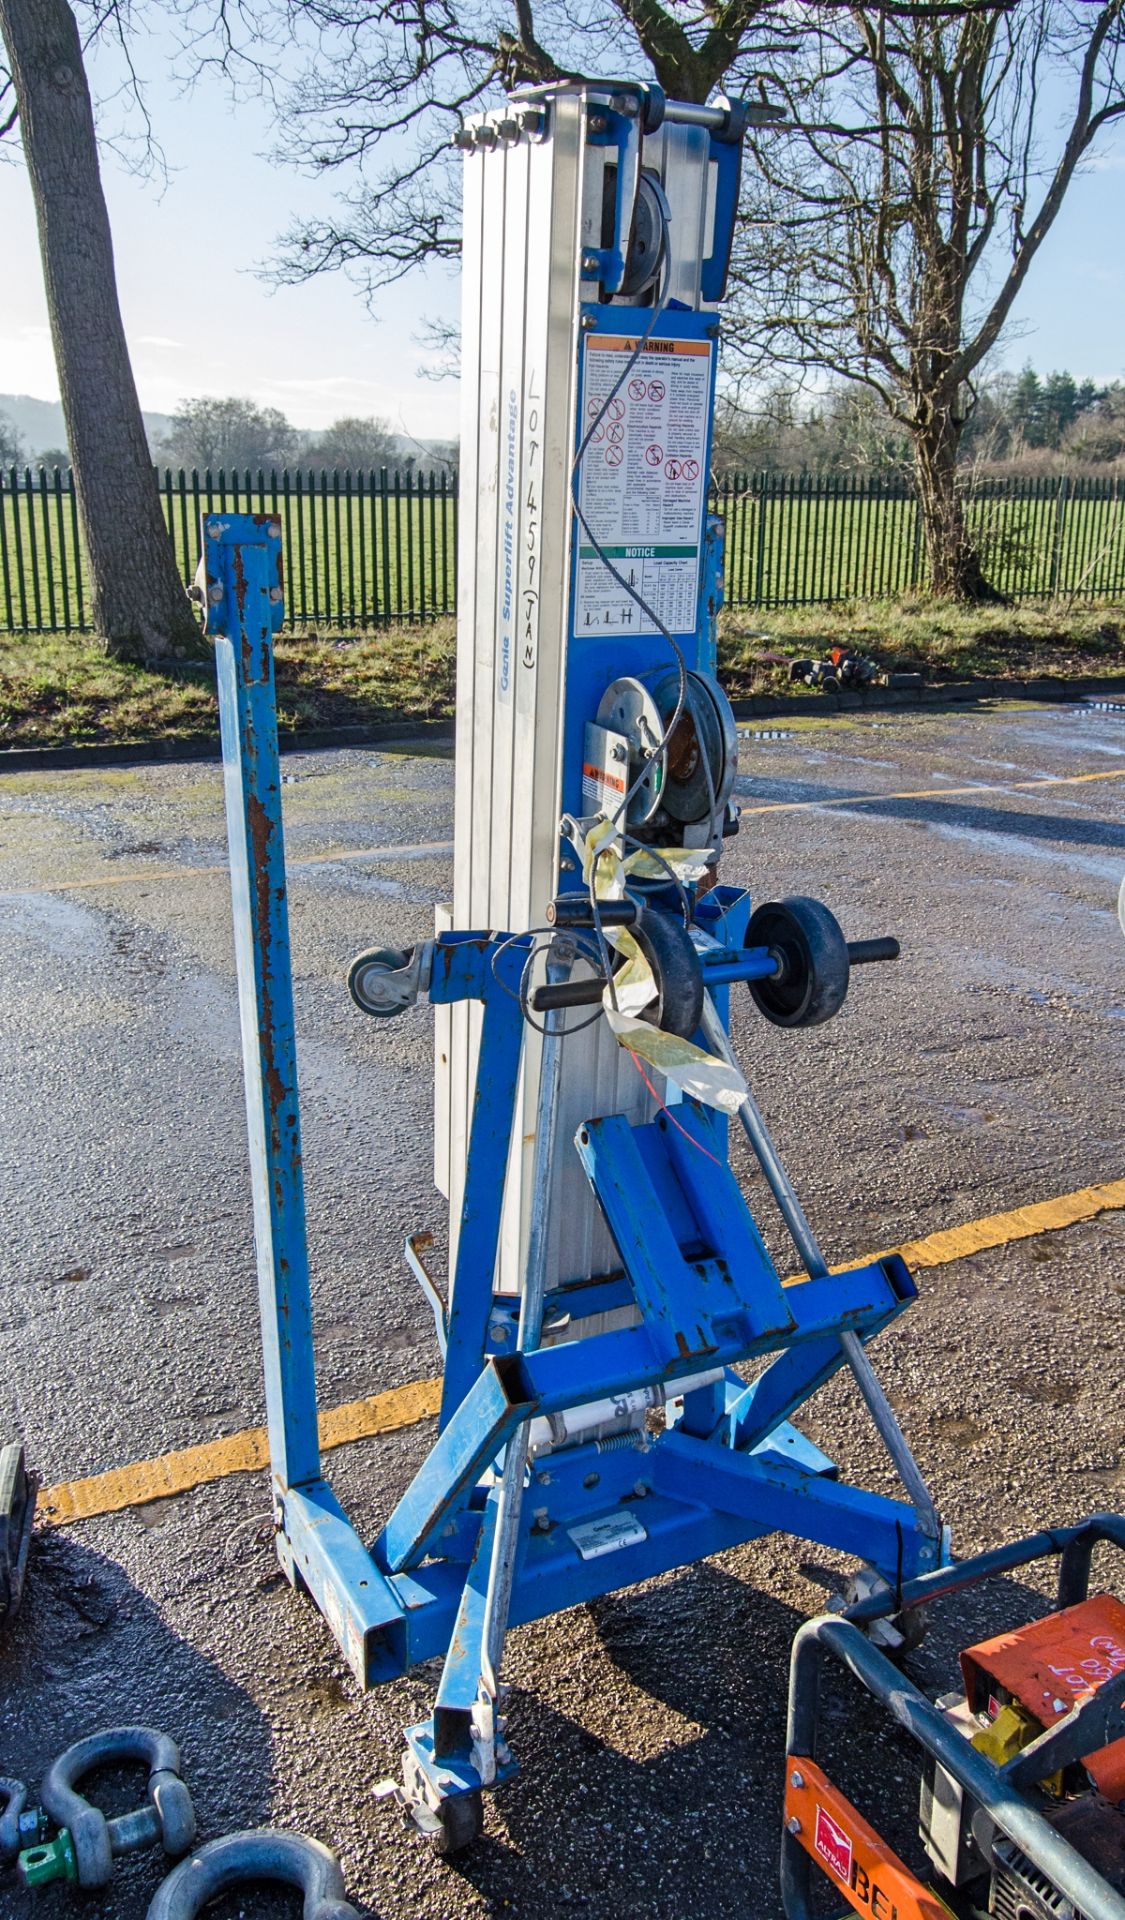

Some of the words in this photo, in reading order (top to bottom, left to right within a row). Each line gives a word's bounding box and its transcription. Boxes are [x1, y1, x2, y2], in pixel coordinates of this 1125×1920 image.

[505, 389, 518, 516] Advantage
[528, 369, 541, 467] LOT
[502, 520, 513, 622] Superlift
[625, 547, 656, 558] NOTICE
[501, 636, 510, 691] Genie
[818, 1840, 848, 1877] ALTRAD
